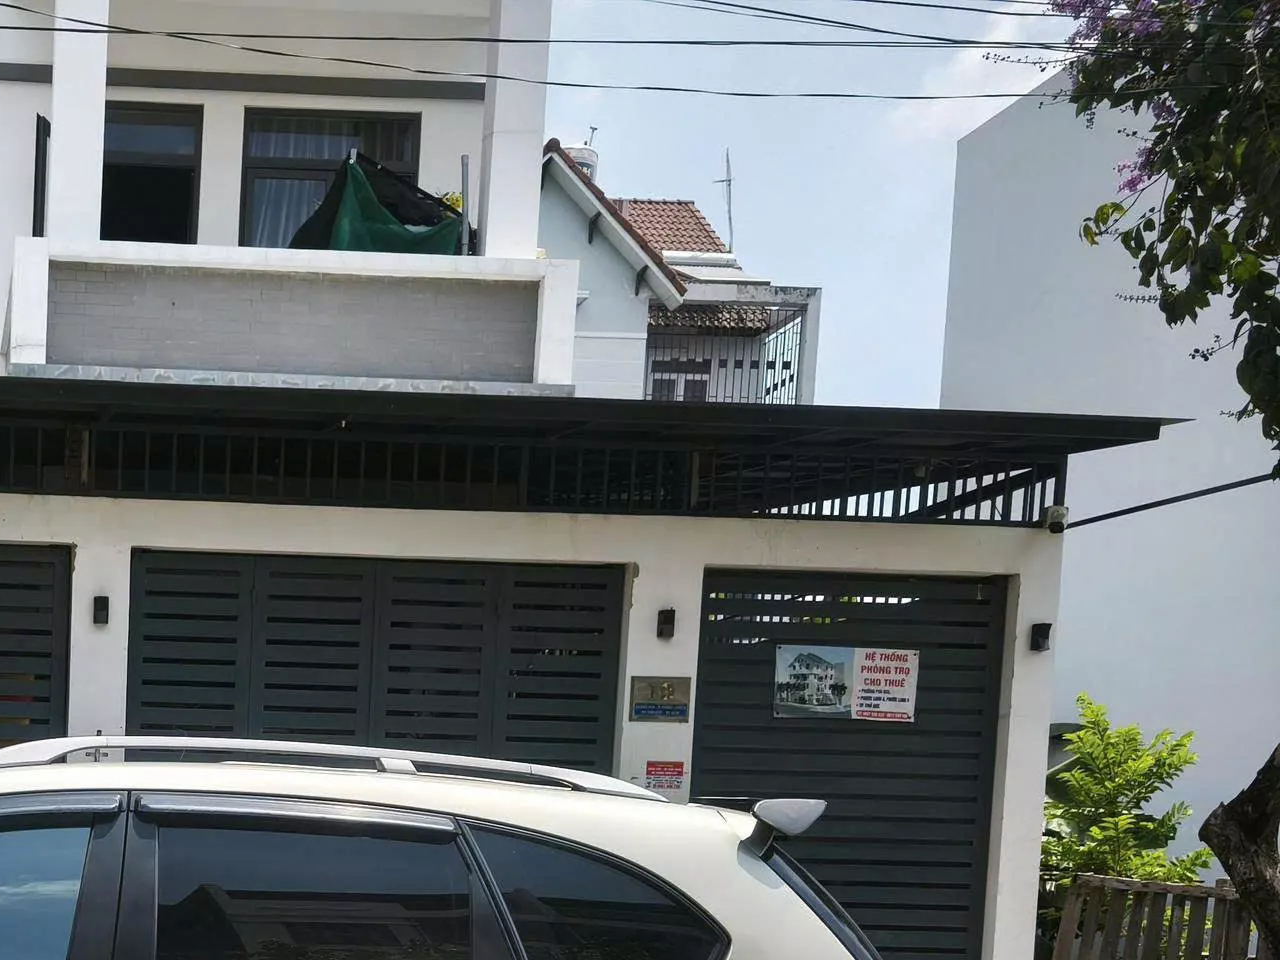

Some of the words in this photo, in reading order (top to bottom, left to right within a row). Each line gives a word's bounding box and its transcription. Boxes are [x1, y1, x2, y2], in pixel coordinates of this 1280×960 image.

[865, 651, 877, 663] HỆ
[879, 650, 909, 663] THỐNG
[860, 664, 892, 675] PHÒNG
[894, 666, 911, 678] TRỌ
[863, 678, 881, 687] CHO
[884, 677, 906, 688] THUÊ
